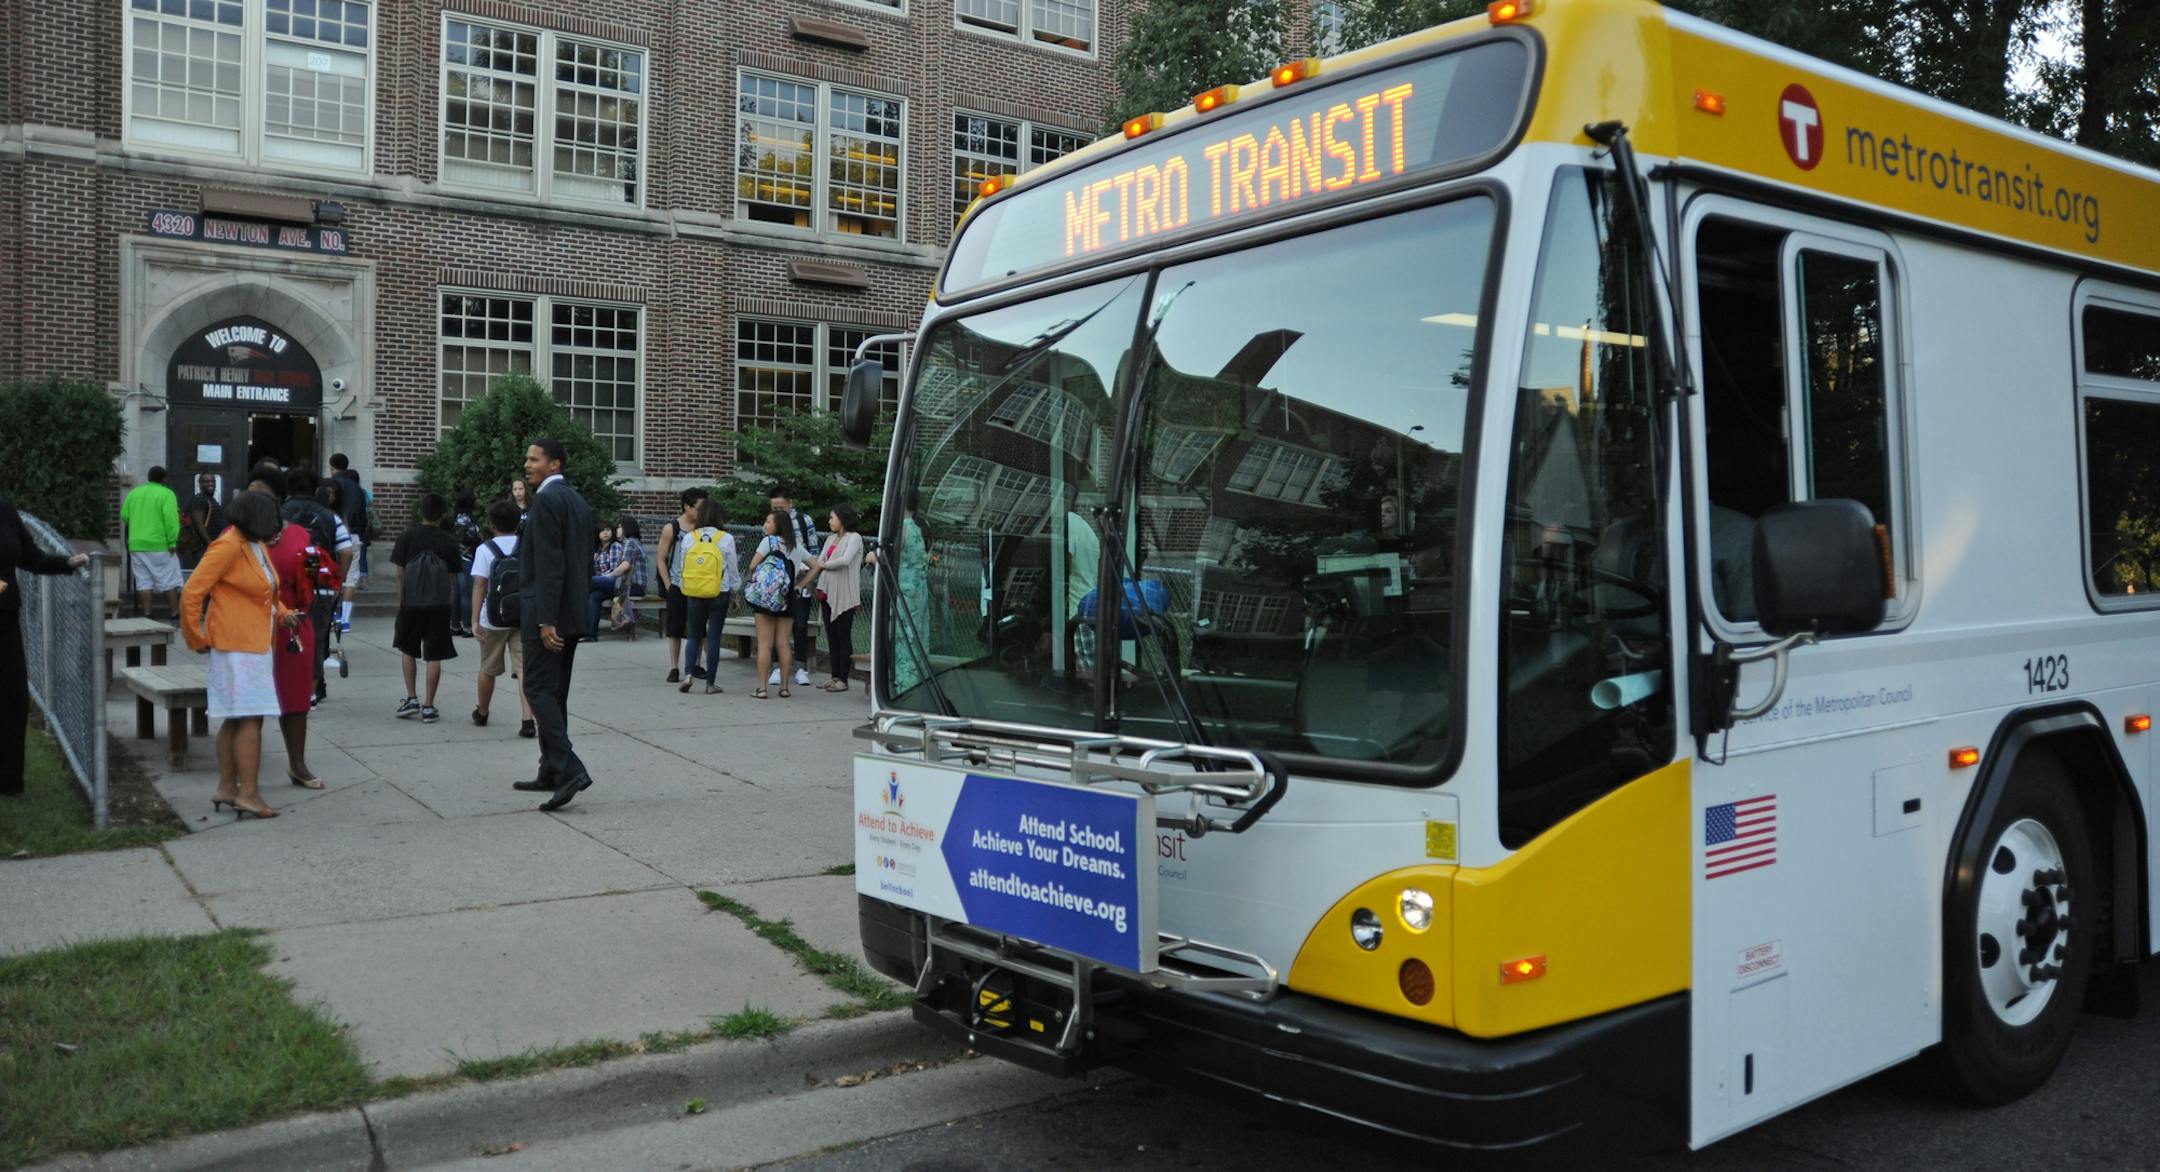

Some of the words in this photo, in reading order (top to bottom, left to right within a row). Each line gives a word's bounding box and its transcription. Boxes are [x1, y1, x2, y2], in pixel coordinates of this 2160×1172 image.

[1782, 99, 1819, 161] T
[1064, 155, 1189, 257] METRO
[1204, 82, 1414, 218] TRANSIT
[1846, 126, 2100, 243] metrotransit.org
[152, 212, 195, 236] 4320
[204, 218, 269, 244] NEWTON
[278, 227, 312, 248] AVE.
[320, 230, 346, 251] NO.
[204, 325, 268, 349] WELCOME
[269, 334, 288, 354] TO
[177, 364, 216, 382] PATRICK
[220, 366, 250, 383] HENRY
[202, 383, 232, 399] MAIN
[236, 385, 290, 401] ENTRANCE
[2023, 654, 2070, 695] 1423
[1781, 699, 1795, 720] of
[1795, 699, 1813, 717] the
[1814, 690, 1877, 715] Metropolitan
[1879, 684, 1913, 706] Council
[858, 812, 886, 832] Attend
[887, 818, 897, 833] to
[900, 821, 935, 842] Achieve
[1019, 813, 1066, 841] Attend
[1068, 823, 1125, 854] School.
[972, 829, 1023, 857] Achieve
[1026, 842, 1060, 865] Your
[1062, 847, 1126, 880] Dreams.
[969, 868, 1128, 933] attendtoachieve.org
